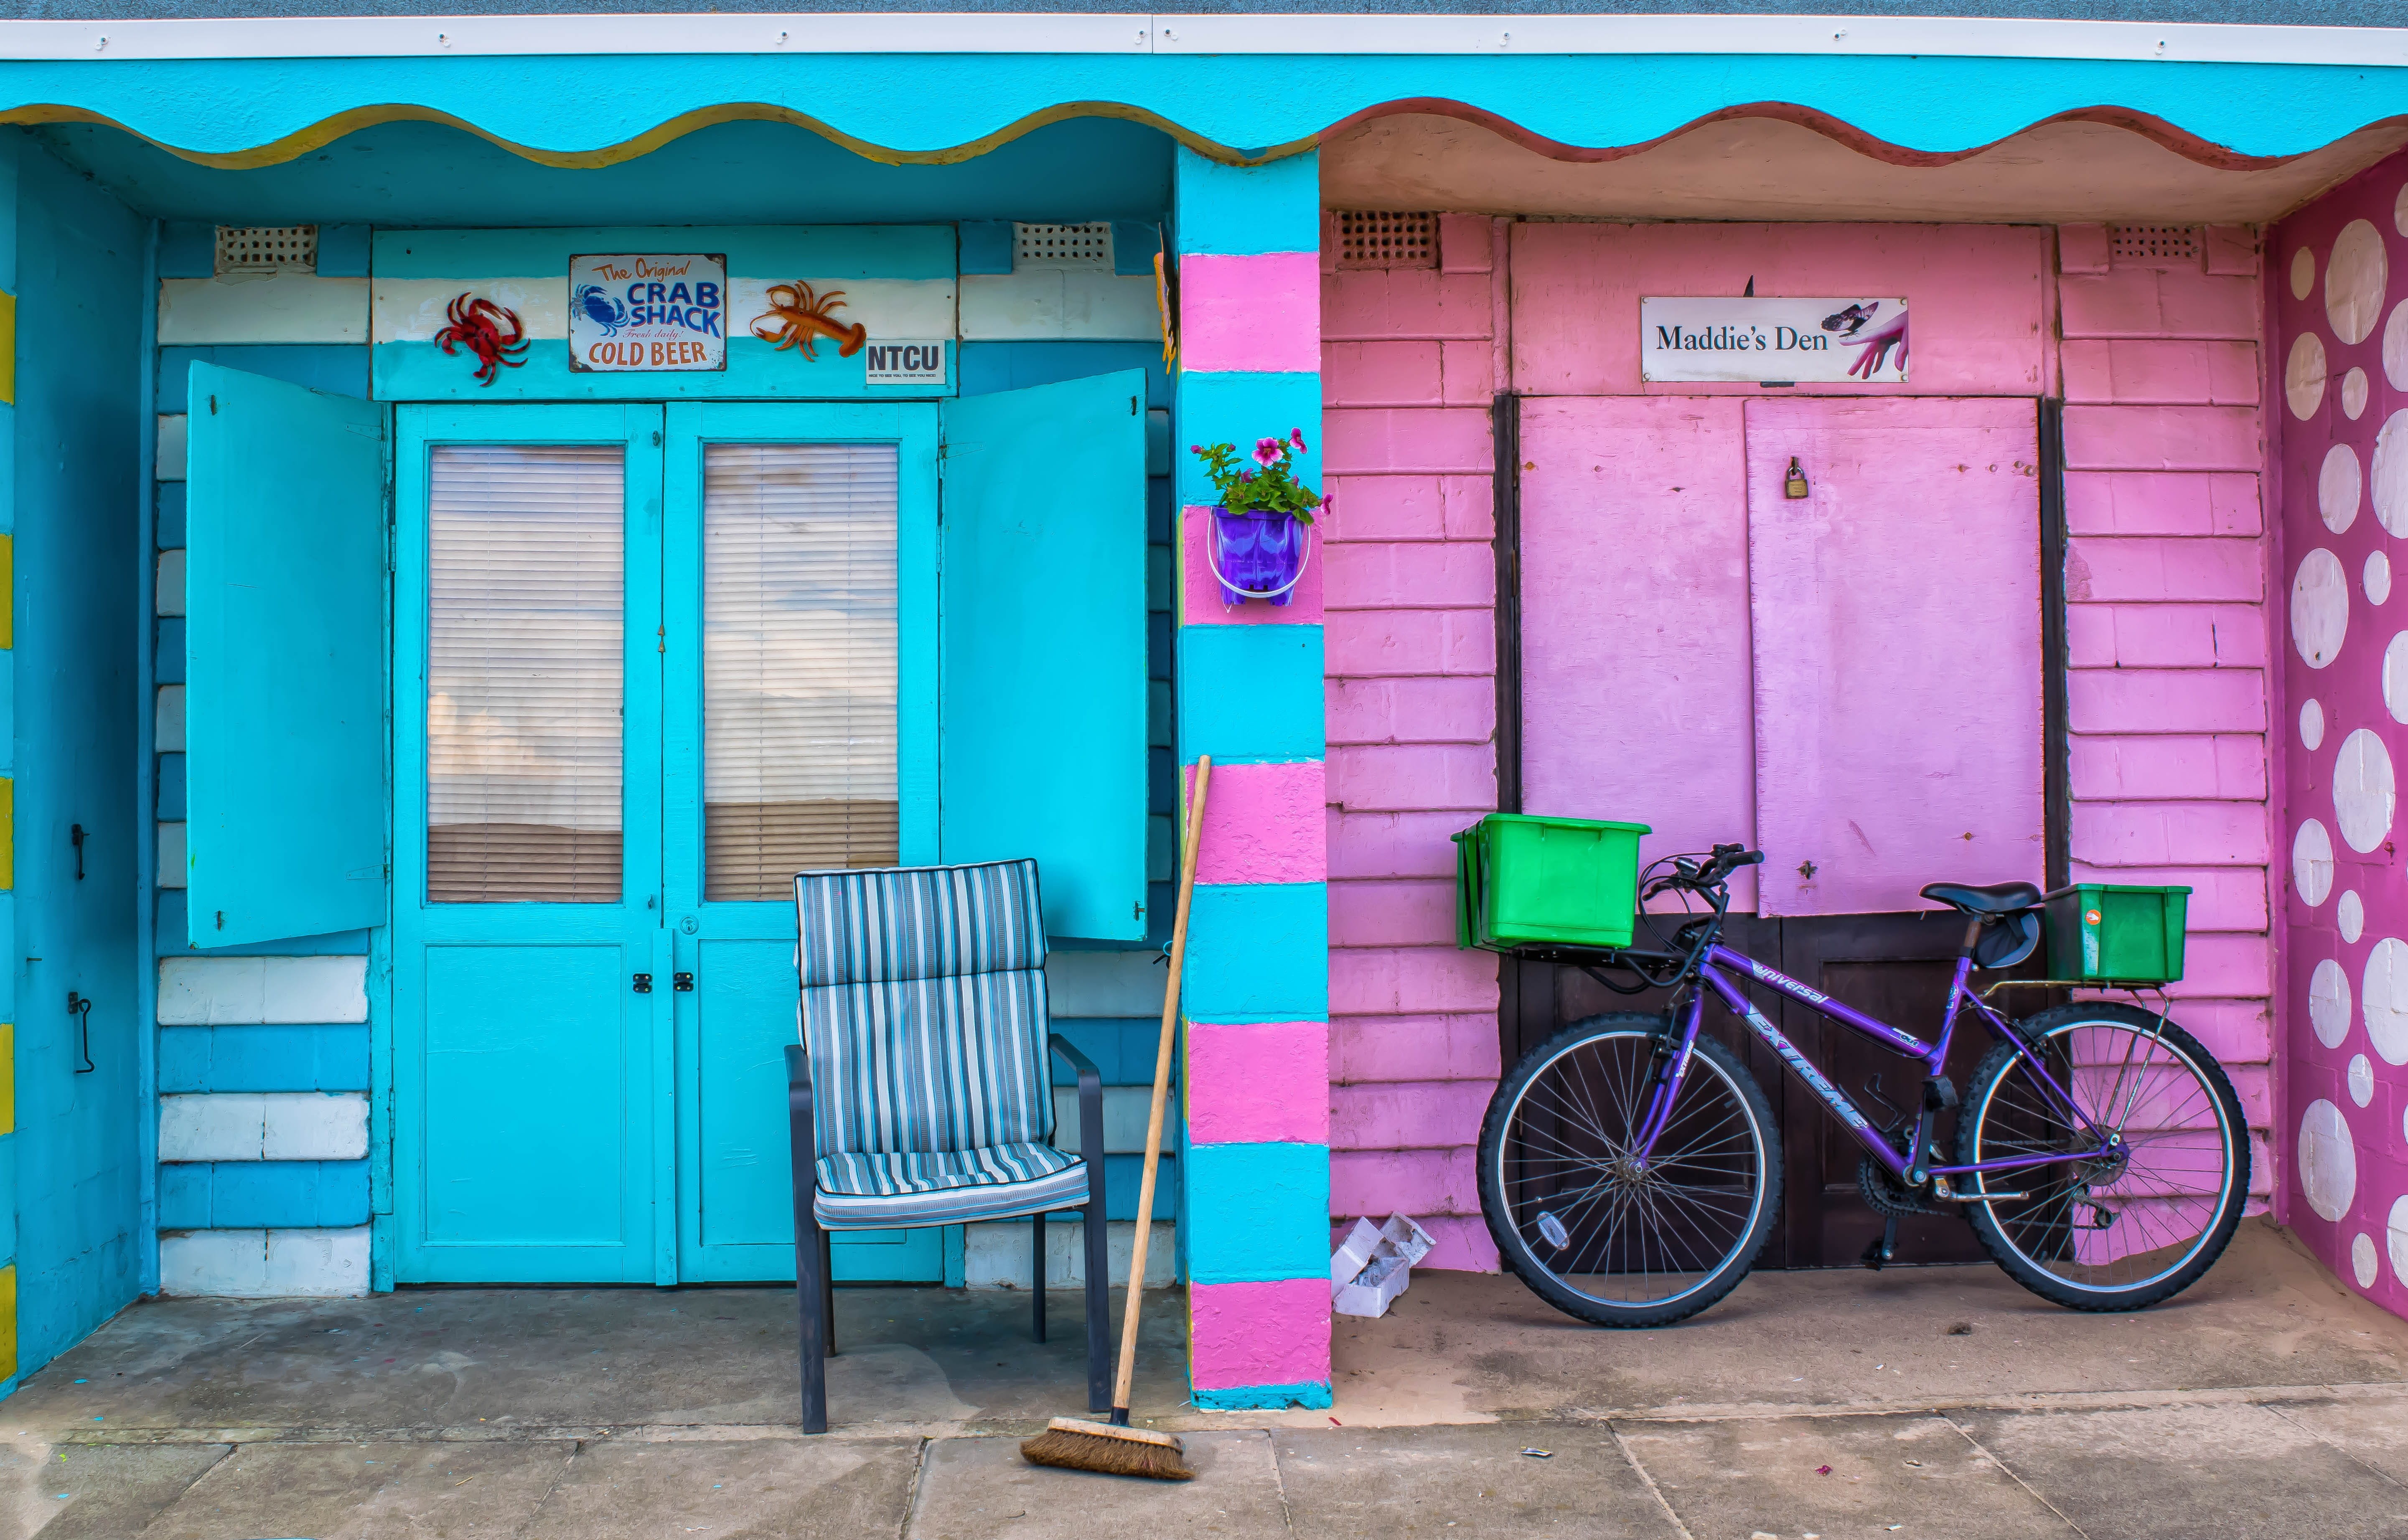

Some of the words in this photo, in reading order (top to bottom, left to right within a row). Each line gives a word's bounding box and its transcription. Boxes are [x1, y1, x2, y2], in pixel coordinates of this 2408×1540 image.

[592, 264, 632, 281] The
[636, 258, 691, 282] Original
[627, 283, 720, 309] CRAB
[623, 329, 651, 338] Fresh
[654, 330, 684, 341] daily!
[631, 305, 721, 339] SHACK
[1656, 325, 1766, 351] Maddie's
[1775, 326, 1828, 351] Den
[589, 342, 644, 366] COLD
[651, 342, 707, 366] BEER
[868, 346, 939, 371] NTCU
[1755, 965, 1828, 1003] universal
[1746, 1012, 1870, 1130] EXTREME
